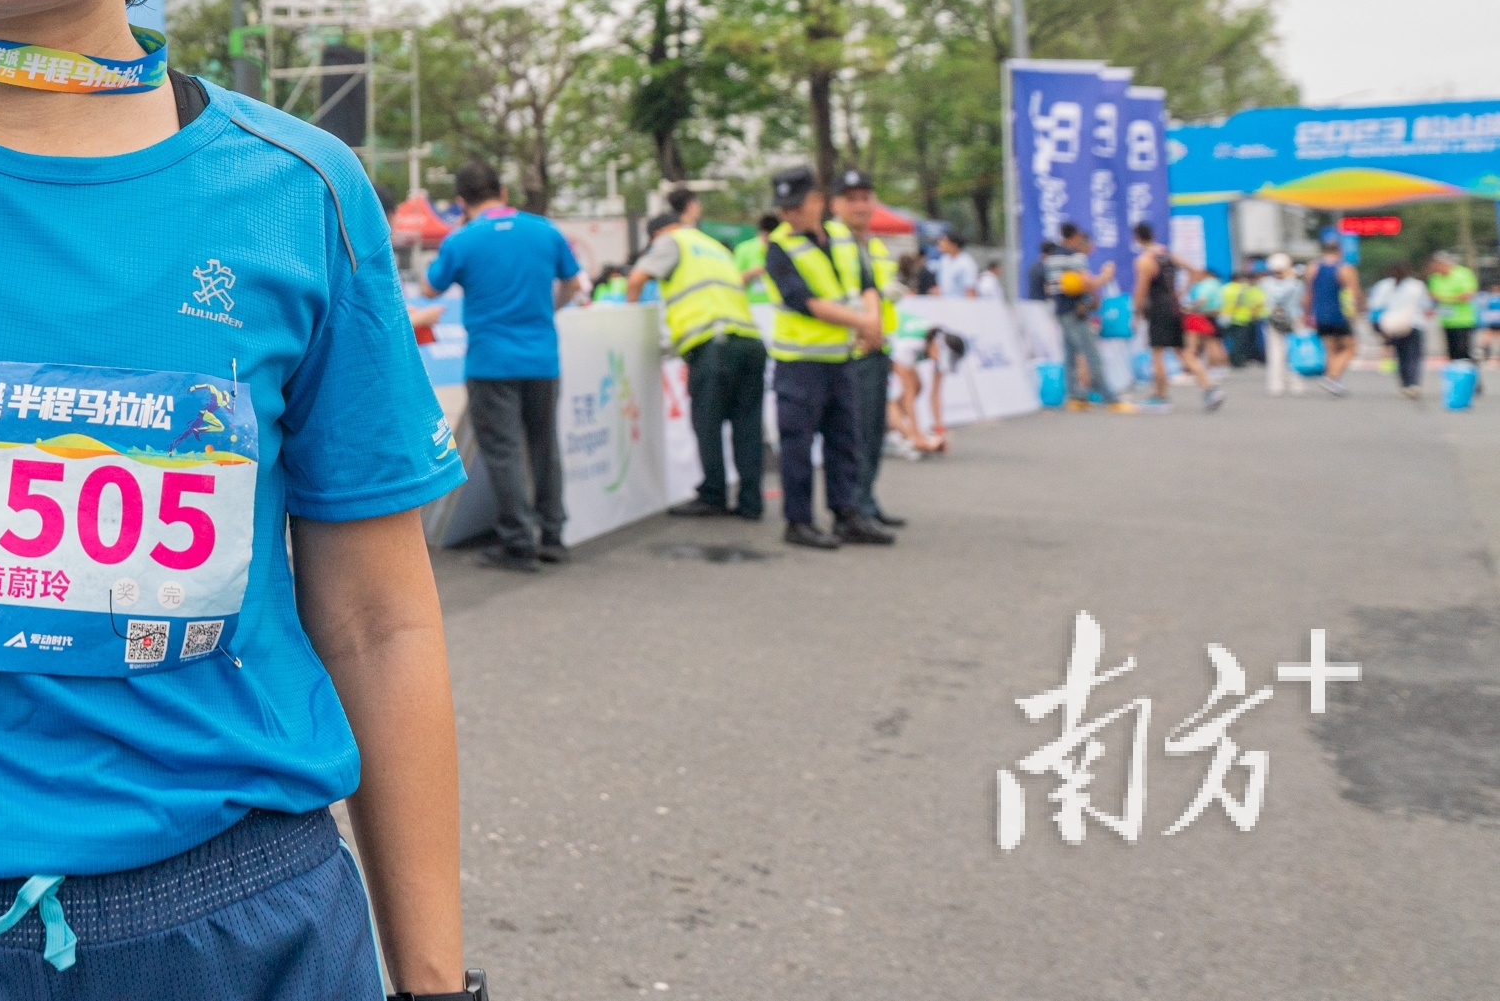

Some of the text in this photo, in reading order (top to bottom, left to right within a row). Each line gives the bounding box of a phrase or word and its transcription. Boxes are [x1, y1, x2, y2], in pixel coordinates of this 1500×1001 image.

[21, 52, 143, 88] 半程马拉松
[7, 383, 175, 431] 半程马拉松
[116, 582, 181, 604] 奖 完
[30, 633, 74, 647] 爱动时代
